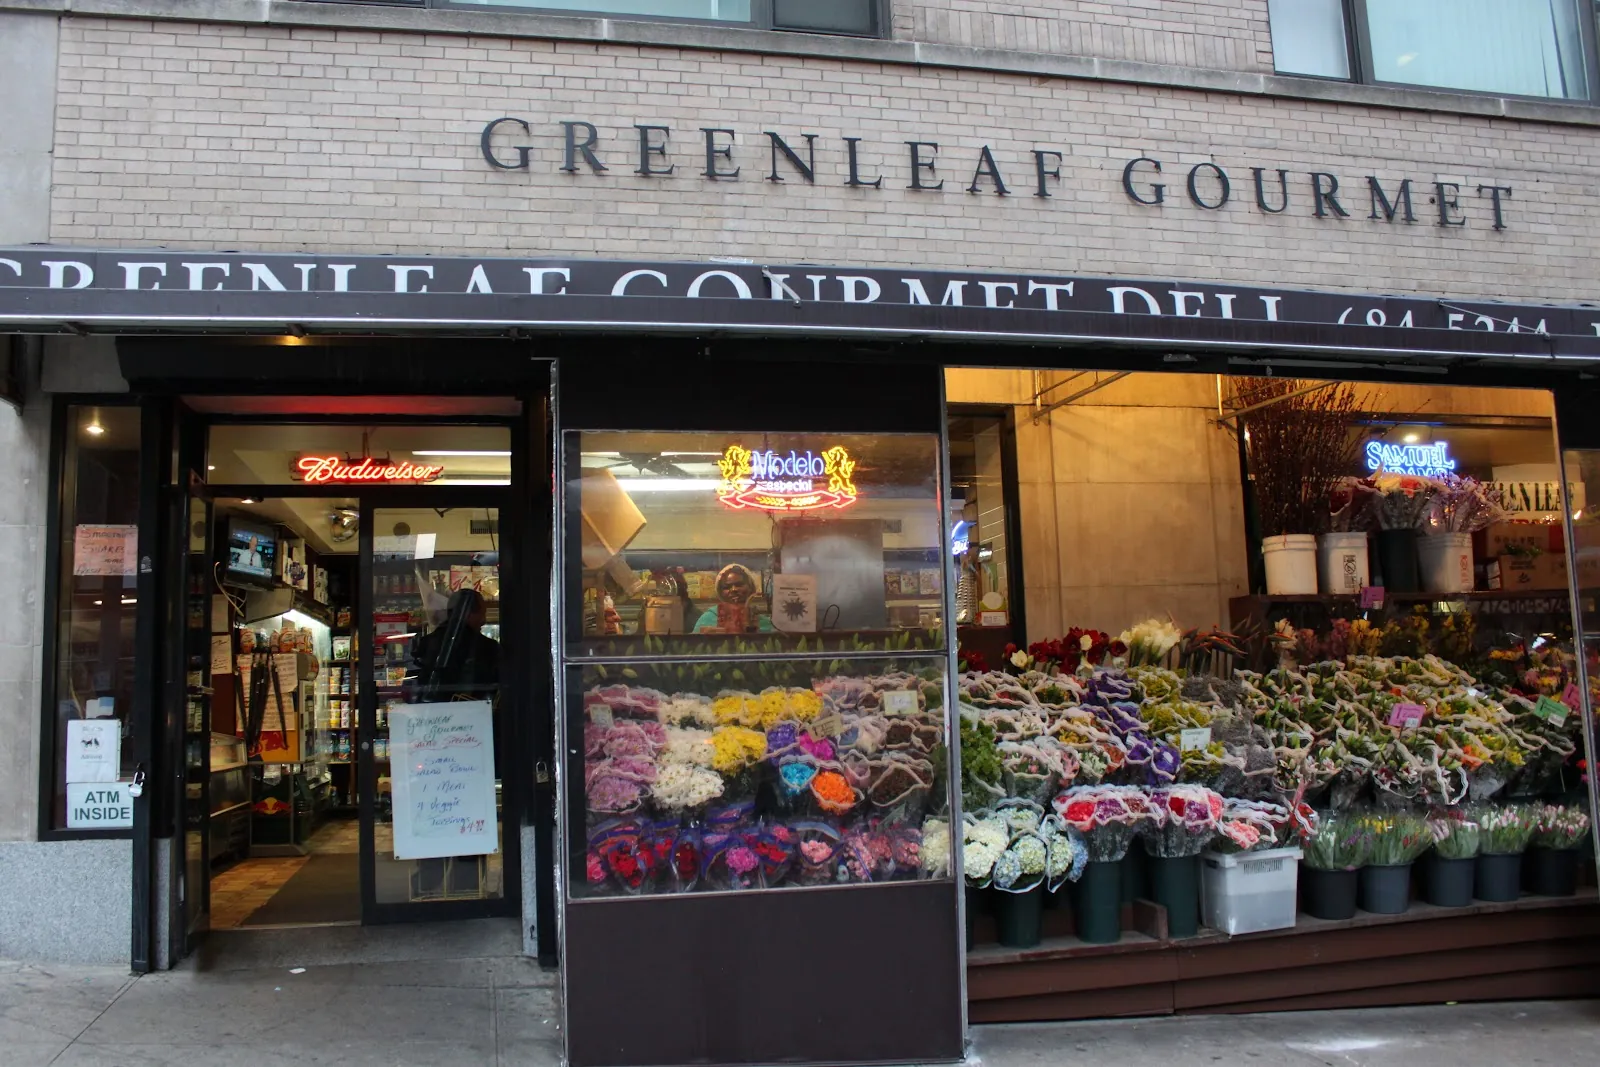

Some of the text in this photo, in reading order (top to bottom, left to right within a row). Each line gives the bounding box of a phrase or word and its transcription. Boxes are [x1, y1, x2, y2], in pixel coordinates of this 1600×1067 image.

[480, 116, 1512, 230] GREENLEAF GOURMET
[298, 456, 443, 482] Budweiser
[751, 450, 824, 480] Modelo
[1366, 441, 1455, 470] SAMUEL
[85, 791, 120, 804] ATM
[74, 807, 131, 821] INSIDE
